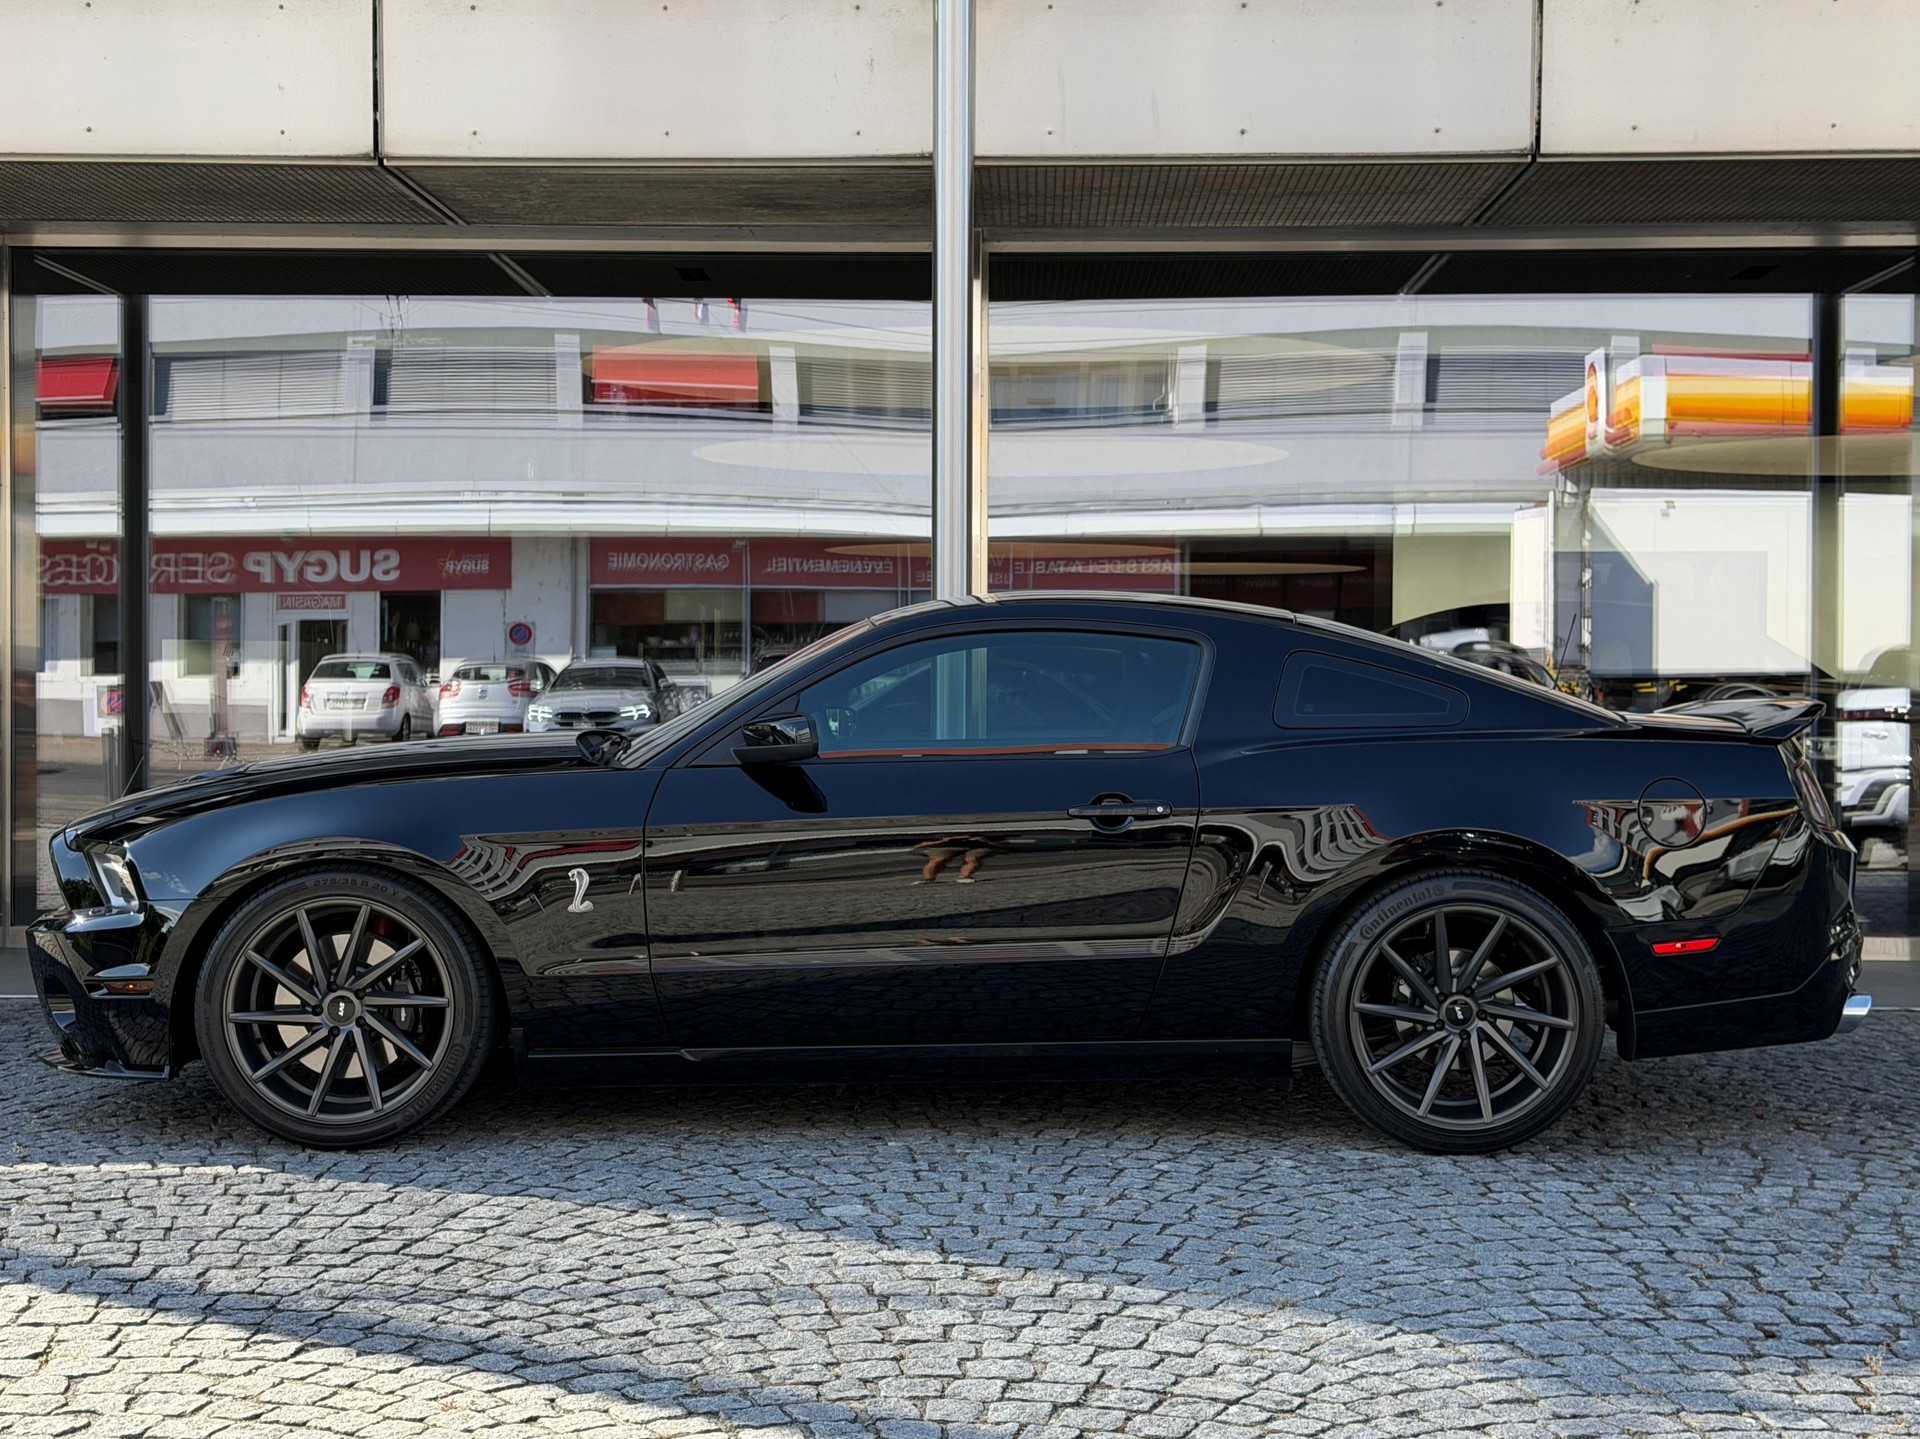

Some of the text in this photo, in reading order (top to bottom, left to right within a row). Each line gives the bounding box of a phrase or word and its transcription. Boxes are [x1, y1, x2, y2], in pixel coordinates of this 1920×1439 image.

[312, 877, 358, 887] 275/35
[371, 882, 388, 892] 20
[1360, 887, 1433, 940] Continental
[1454, 1005, 1464, 1020] SVT
[413, 1042, 466, 1114] Continental
